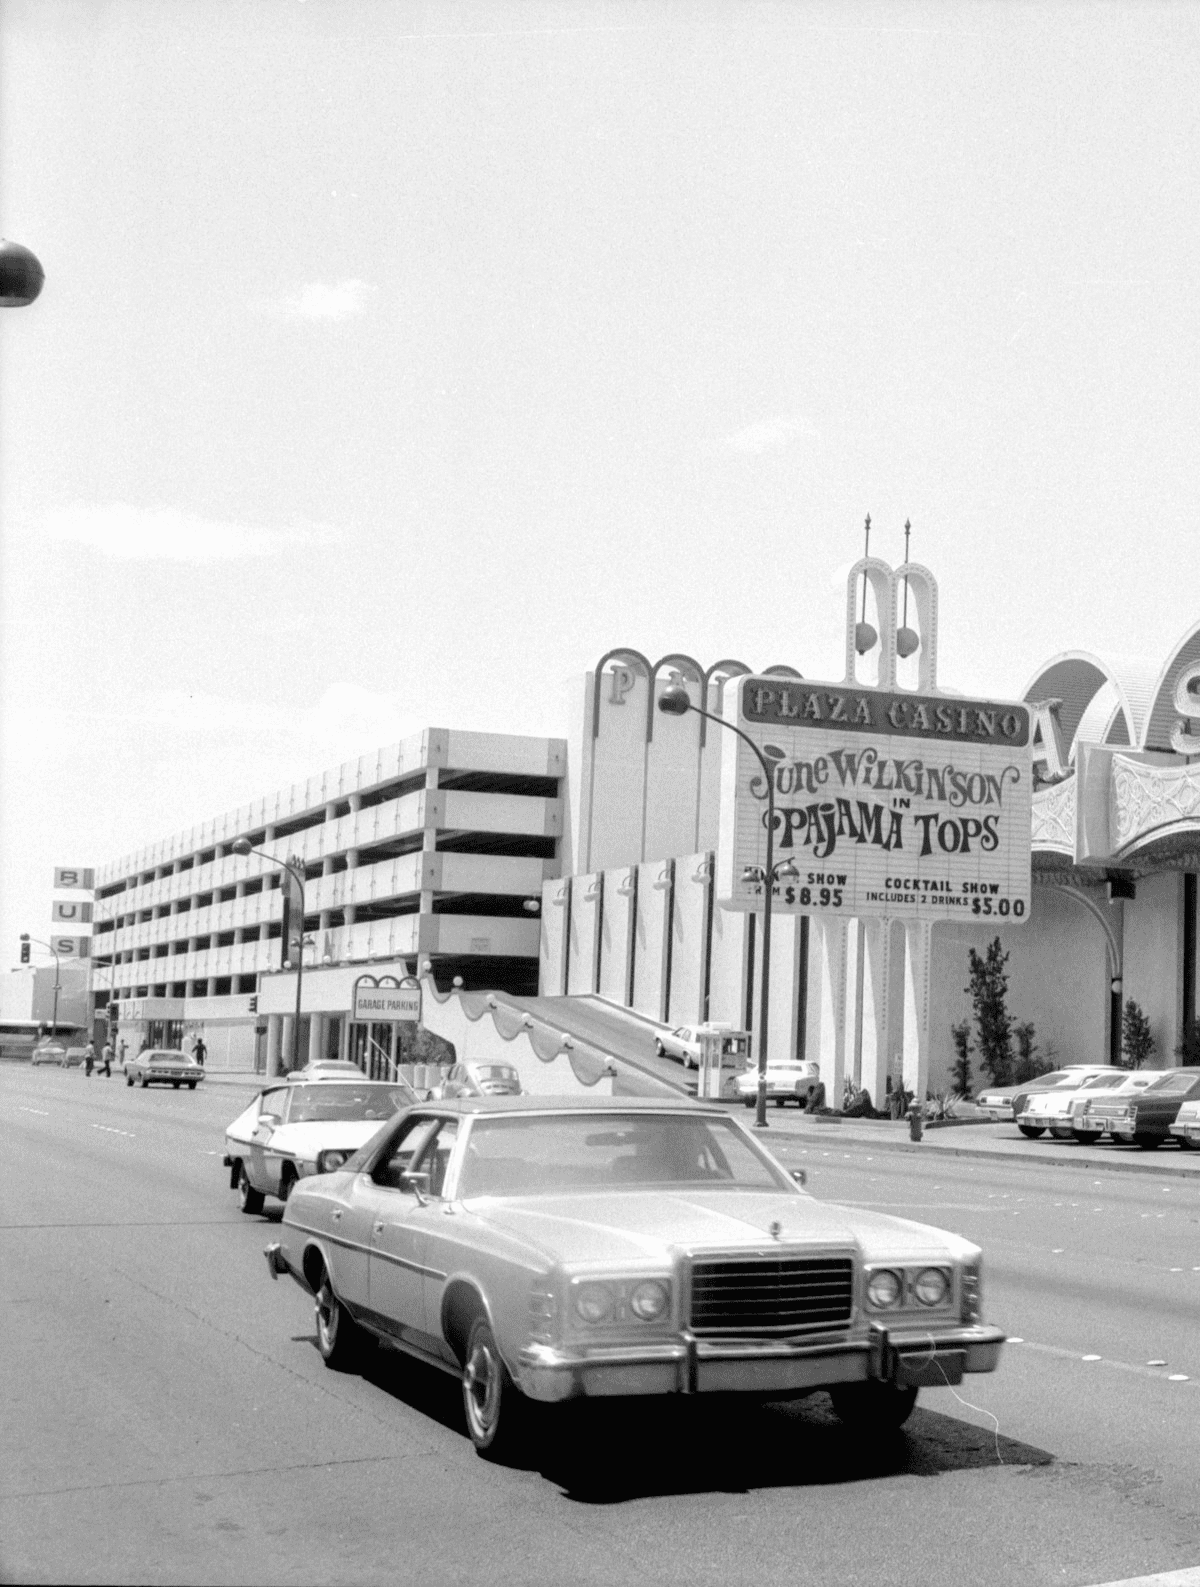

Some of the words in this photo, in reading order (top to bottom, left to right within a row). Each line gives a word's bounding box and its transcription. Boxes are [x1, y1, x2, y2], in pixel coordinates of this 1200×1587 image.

[750, 687, 877, 726] PLAZA
[888, 701, 1023, 739] CASINO
[893, 798, 911, 809] IN
[913, 813, 1001, 857] TOPS
[807, 872, 848, 886] SHOW
[885, 877, 953, 892] COCKTAIL
[962, 881, 1000, 895] SHOW
[785, 886, 843, 907] $8.95
[866, 891, 916, 904] INCLUDES
[921, 894, 928, 904] 2
[931, 895, 969, 907] DRINKS
[971, 897, 1025, 917] $5.00
[57, 870, 78, 954] BUS
[358, 999, 385, 1010] GARAGE
[387, 1000, 419, 1012] PARKING
